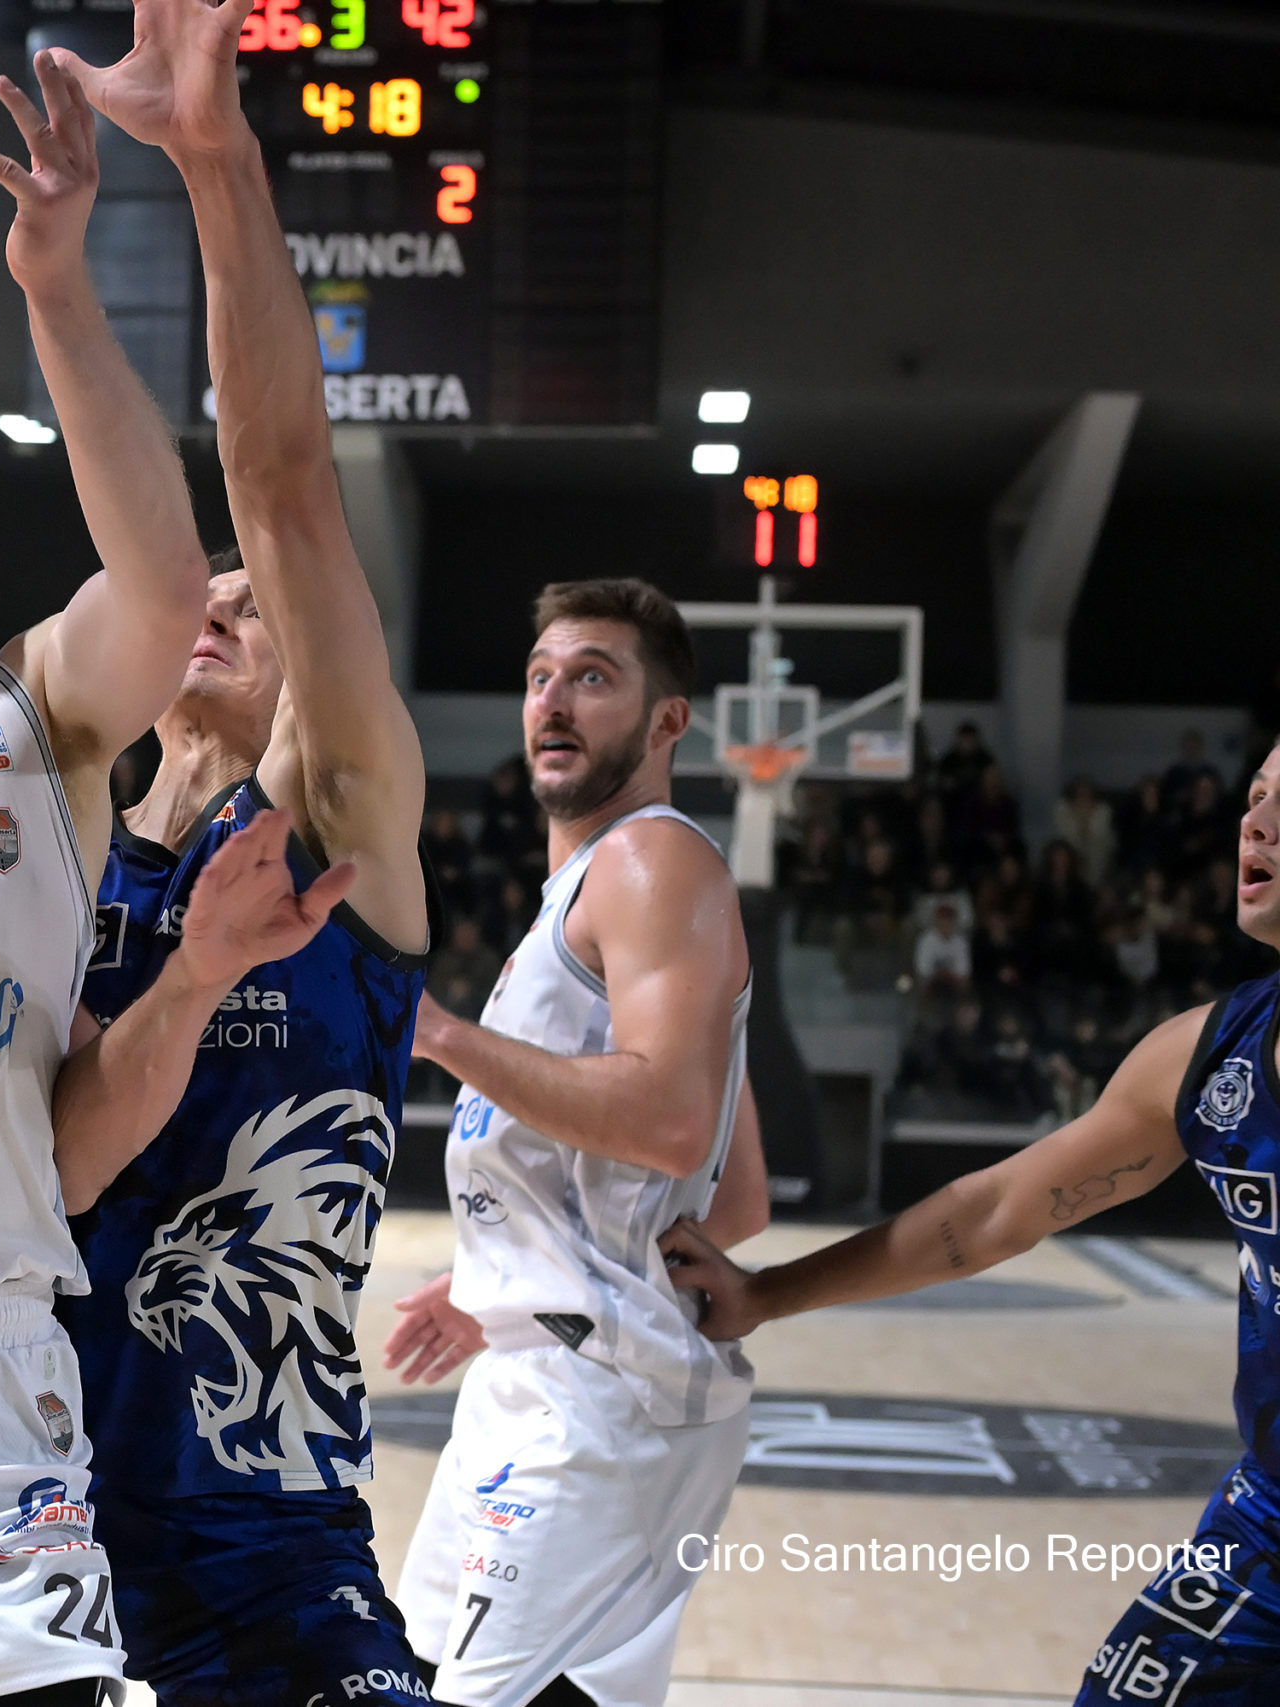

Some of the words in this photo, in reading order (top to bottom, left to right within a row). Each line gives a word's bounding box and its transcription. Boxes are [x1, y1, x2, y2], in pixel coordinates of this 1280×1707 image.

[330, 0, 366, 50] 3
[401, 0, 475, 49] 42
[302, 78, 421, 137] 4:18
[436, 164, 477, 224] 2
[284, 231, 465, 278] OVINCIA
[754, 510, 817, 568] 11
[1209, 1174, 1263, 1220] IG
[44, 1572, 112, 1648] 24
[454, 1592, 494, 1660] 7
[339, 1668, 432, 1703] ROMA
